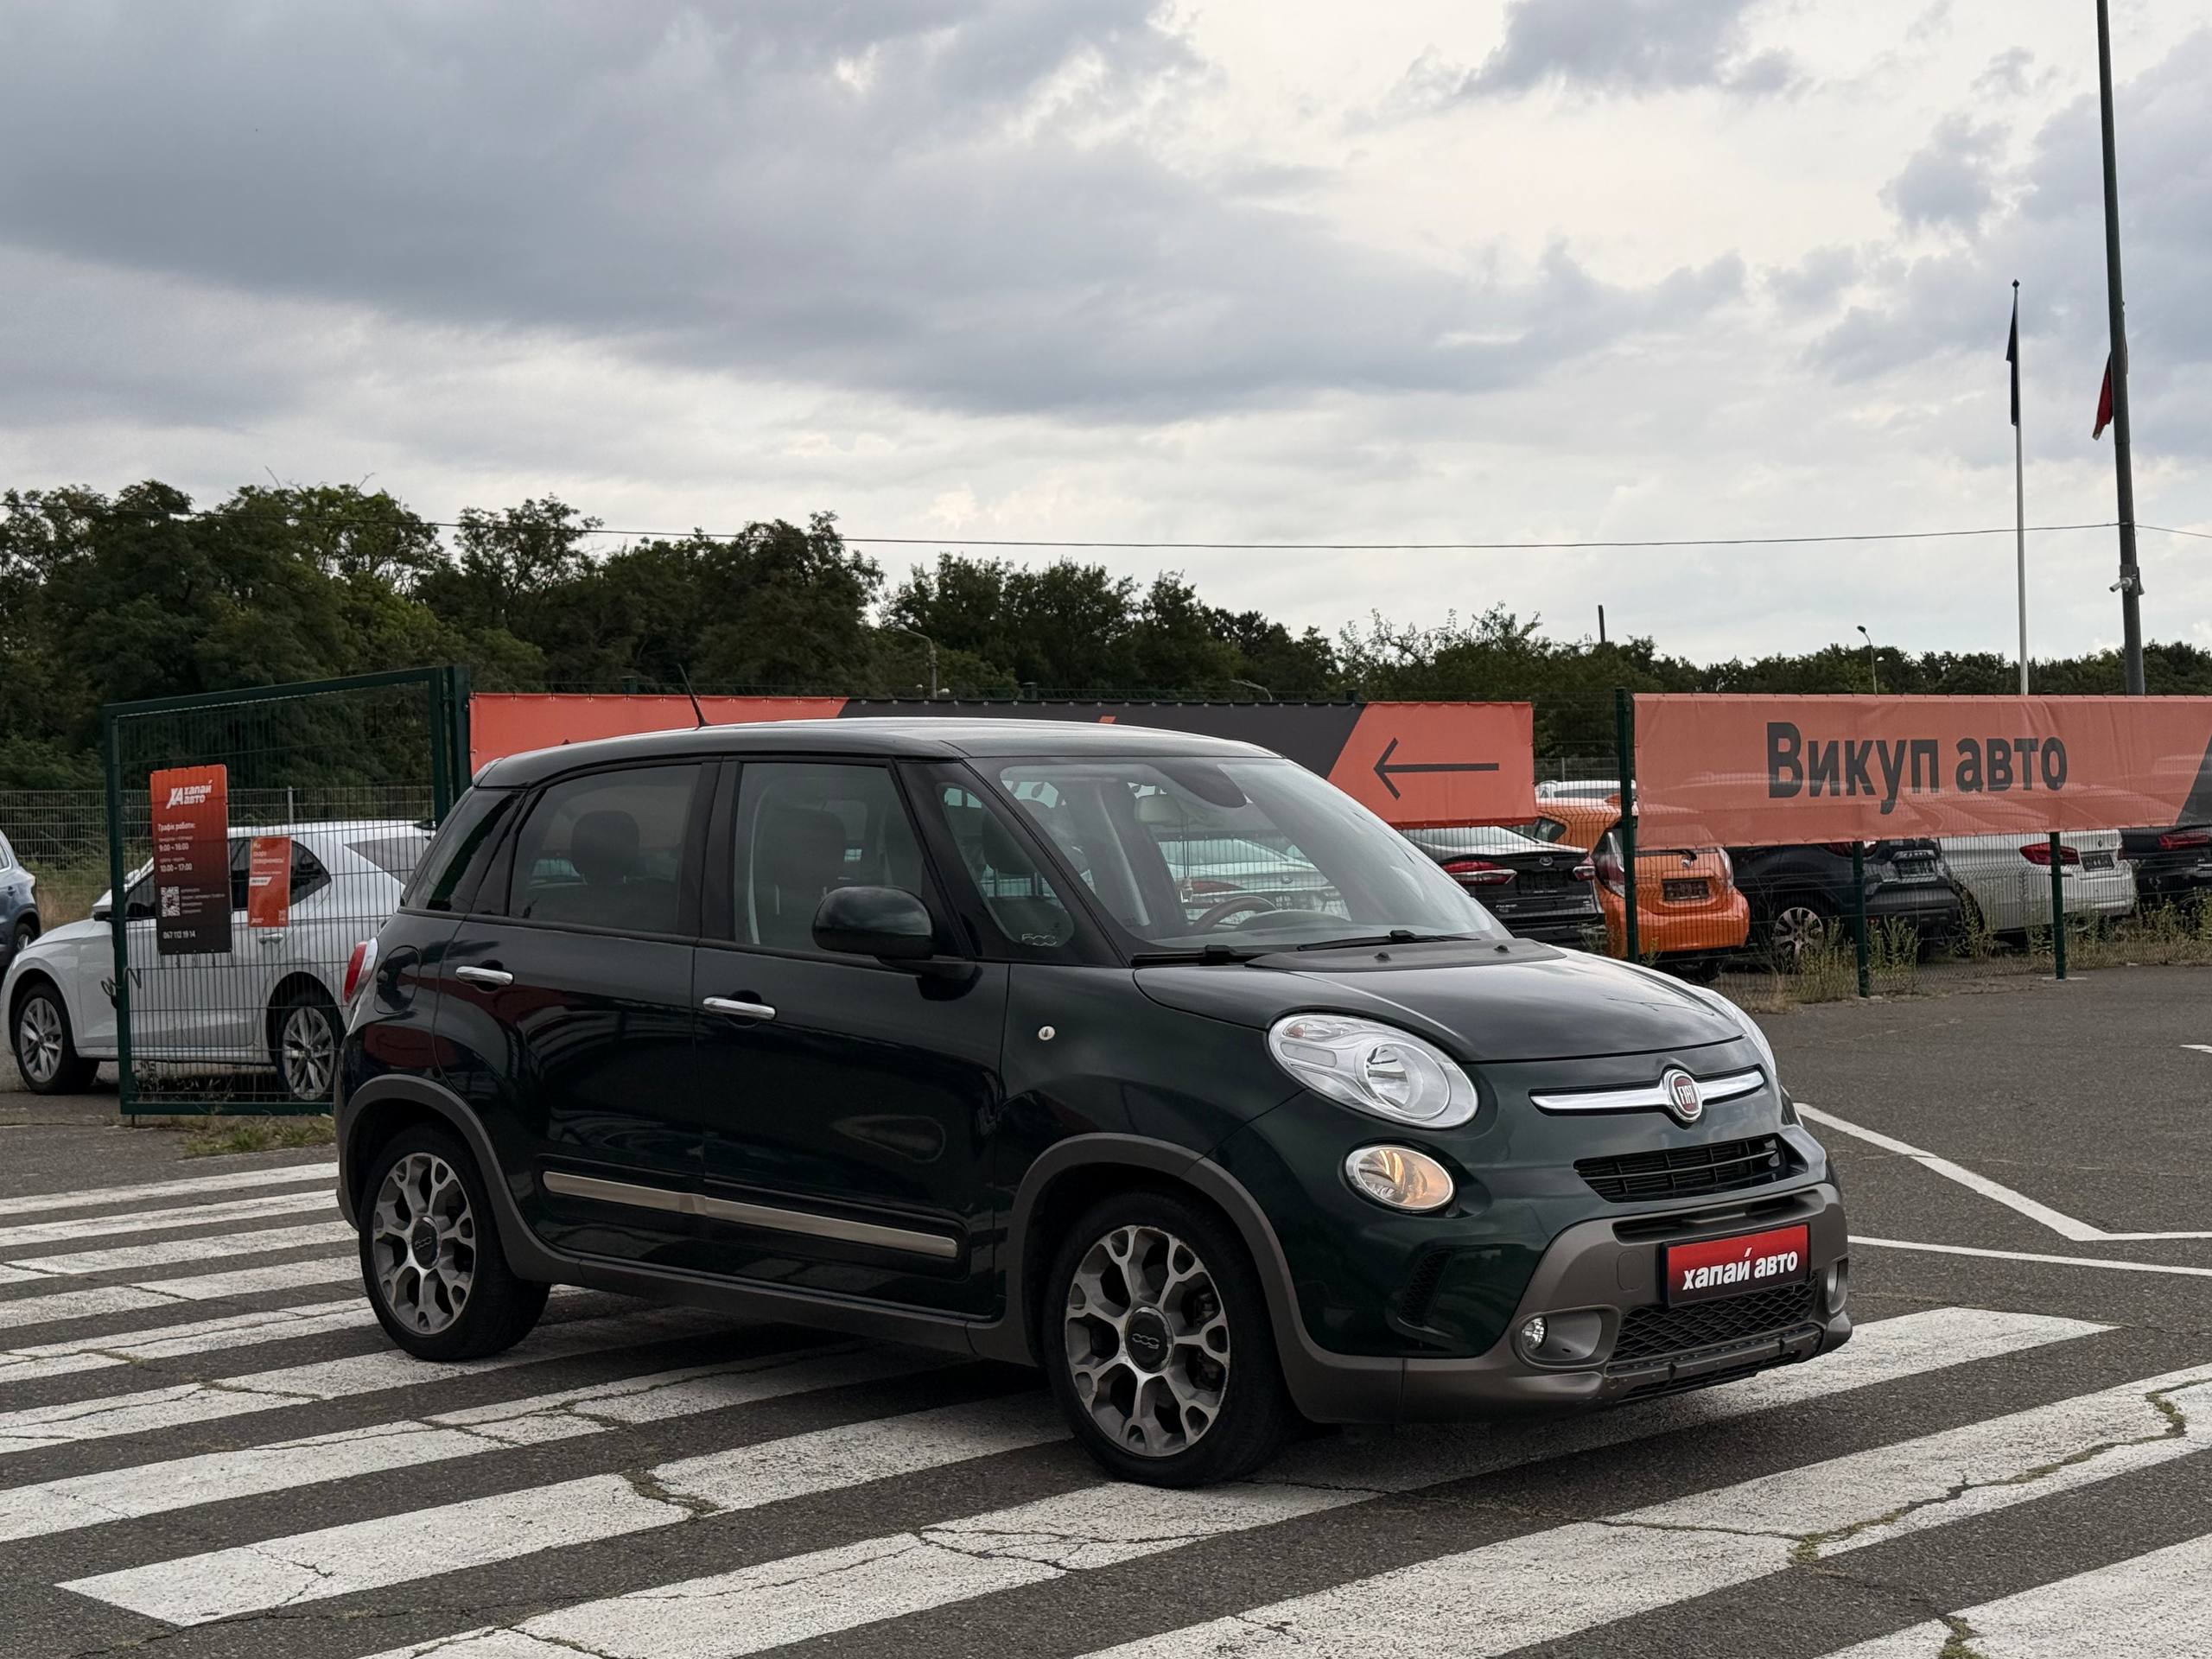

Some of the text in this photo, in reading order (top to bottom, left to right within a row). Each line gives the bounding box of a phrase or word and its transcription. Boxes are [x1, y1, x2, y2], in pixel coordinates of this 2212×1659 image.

[1767, 721, 2069, 815] Викуп авто
[184, 794, 207, 805] авто
[1677, 1084, 1696, 1105] FIAT
[1682, 1247, 1798, 1290] хапай авто
